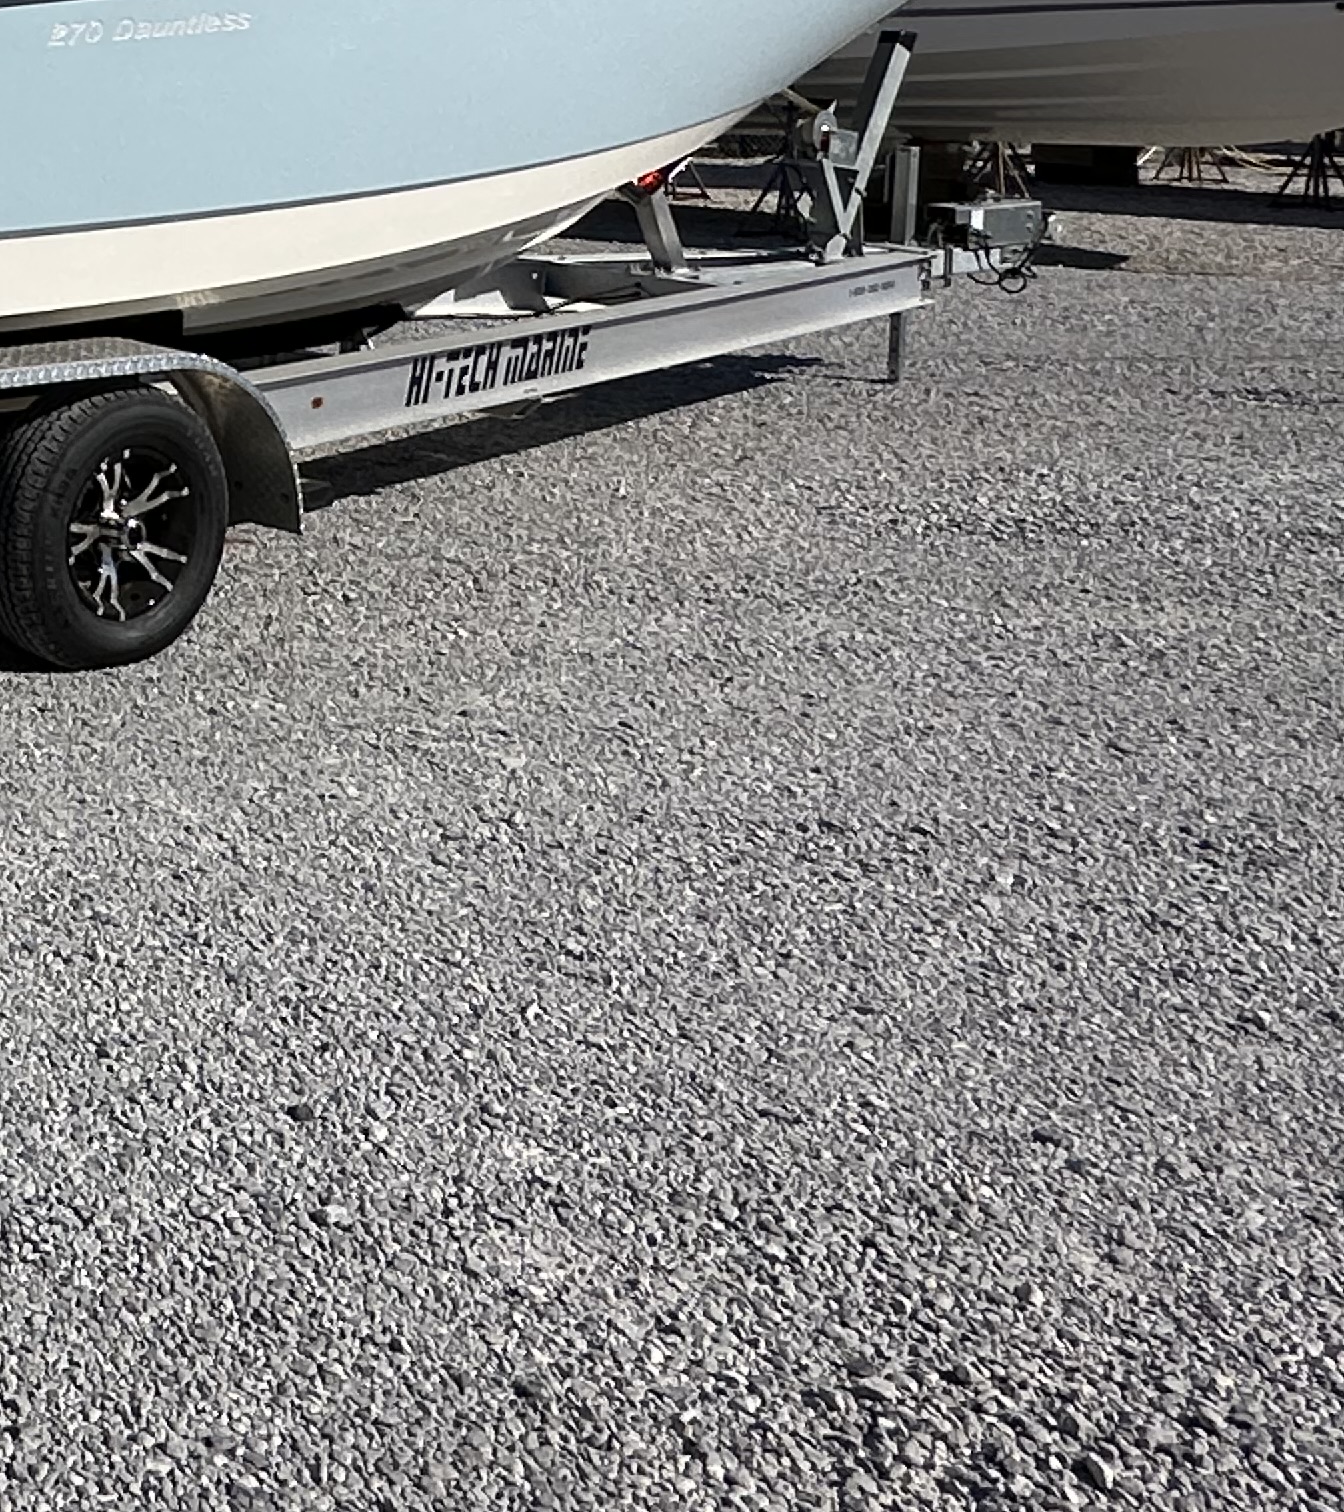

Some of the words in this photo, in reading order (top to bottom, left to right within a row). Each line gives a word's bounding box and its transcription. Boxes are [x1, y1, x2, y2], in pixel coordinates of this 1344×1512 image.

[47, 19, 104, 46] 270
[112, 12, 252, 42] Dauntless
[404, 342, 502, 407] HI-TECH
